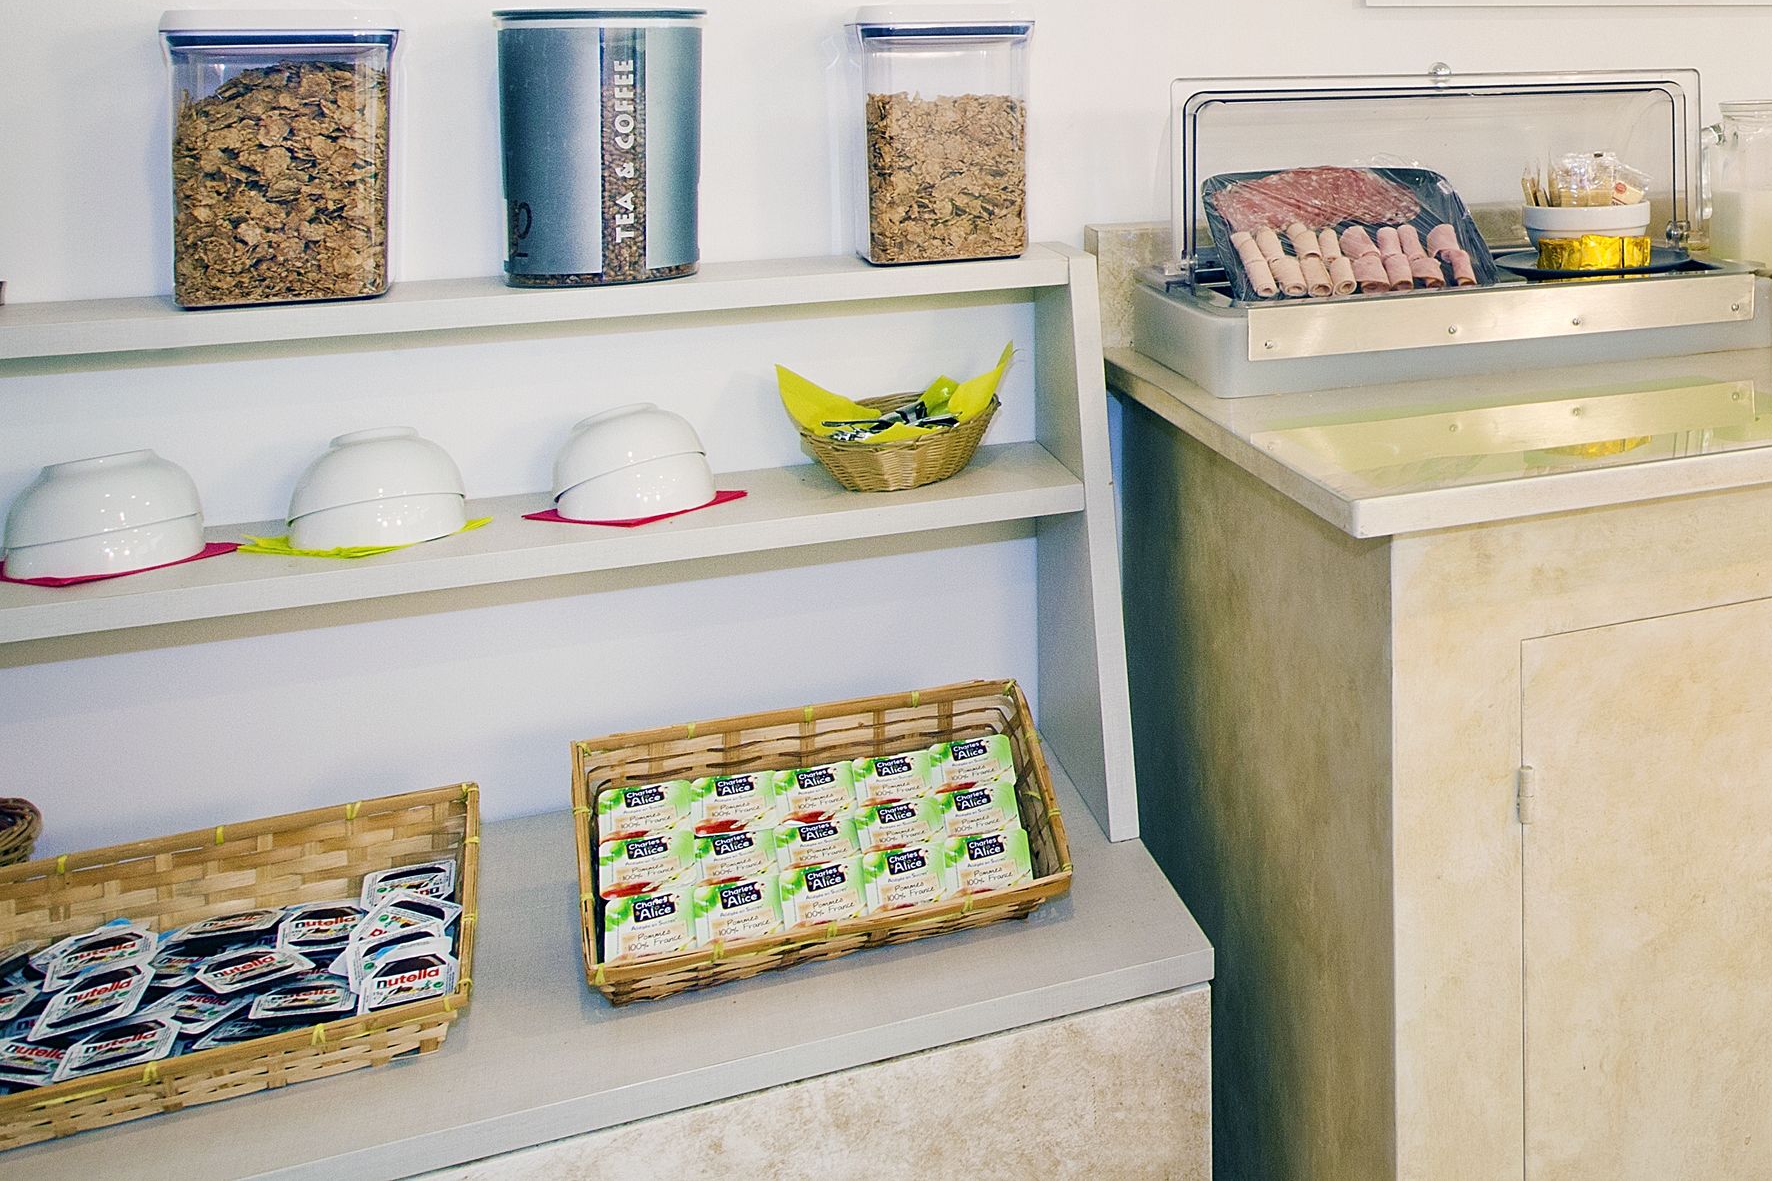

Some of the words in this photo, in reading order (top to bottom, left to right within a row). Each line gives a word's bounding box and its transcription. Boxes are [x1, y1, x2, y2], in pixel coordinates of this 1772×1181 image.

[613, 59, 634, 149] COFFEE
[615, 162, 634, 179] &
[616, 192, 634, 243] TEA
[953, 743, 980, 752] Charles
[958, 748, 984, 759] Alice
[877, 759, 904, 768] Charles
[798, 770, 826, 780] Charles
[881, 765, 909, 775] Alice
[718, 778, 747, 787] Charles
[804, 776, 832, 787] Alice
[626, 789, 657, 799] Charles
[721, 784, 751, 795] Alice
[630, 794, 661, 806] Alice
[956, 791, 983, 802] Charles
[961, 797, 988, 809] Alice
[879, 806, 907, 815] Charles
[885, 811, 913, 822] Alice
[801, 824, 830, 833] Charles
[806, 829, 835, 840] Alice
[629, 840, 660, 850] Charles
[715, 835, 745, 846] Charles
[720, 840, 750, 853] Alice
[969, 838, 997, 849] Charles
[633, 845, 664, 858] Alice
[973, 845, 1001, 858] Alice
[889, 852, 918, 864] Charles
[894, 859, 923, 873] Alice
[974, 866, 1002, 876] Pommes
[807, 868, 837, 881] Charles
[966, 877, 985, 886] 100%
[988, 871, 1013, 881] France
[812, 875, 842, 890] Alice
[895, 881, 924, 892] Pommes
[722, 886, 753, 898] Charles
[887, 892, 906, 901] 100%
[909, 886, 935, 896] France
[635, 897, 668, 910] Charles
[727, 892, 758, 907] Alice
[813, 897, 843, 909] Pommes
[639, 905, 672, 920] Alice
[805, 908, 824, 918] 100%
[828, 902, 855, 913] France
[295, 916, 356, 929] nutella
[727, 914, 759, 926] Pommes
[718, 926, 739, 936] 100%
[743, 919, 770, 930] France
[638, 929, 671, 941] Pommes
[628, 941, 649, 951] 100%
[654, 934, 682, 946] France
[213, 955, 276, 978] nutella
[376, 967, 440, 989] nutella
[64, 979, 132, 1005] nutella
[84, 1031, 157, 1054] nutella
